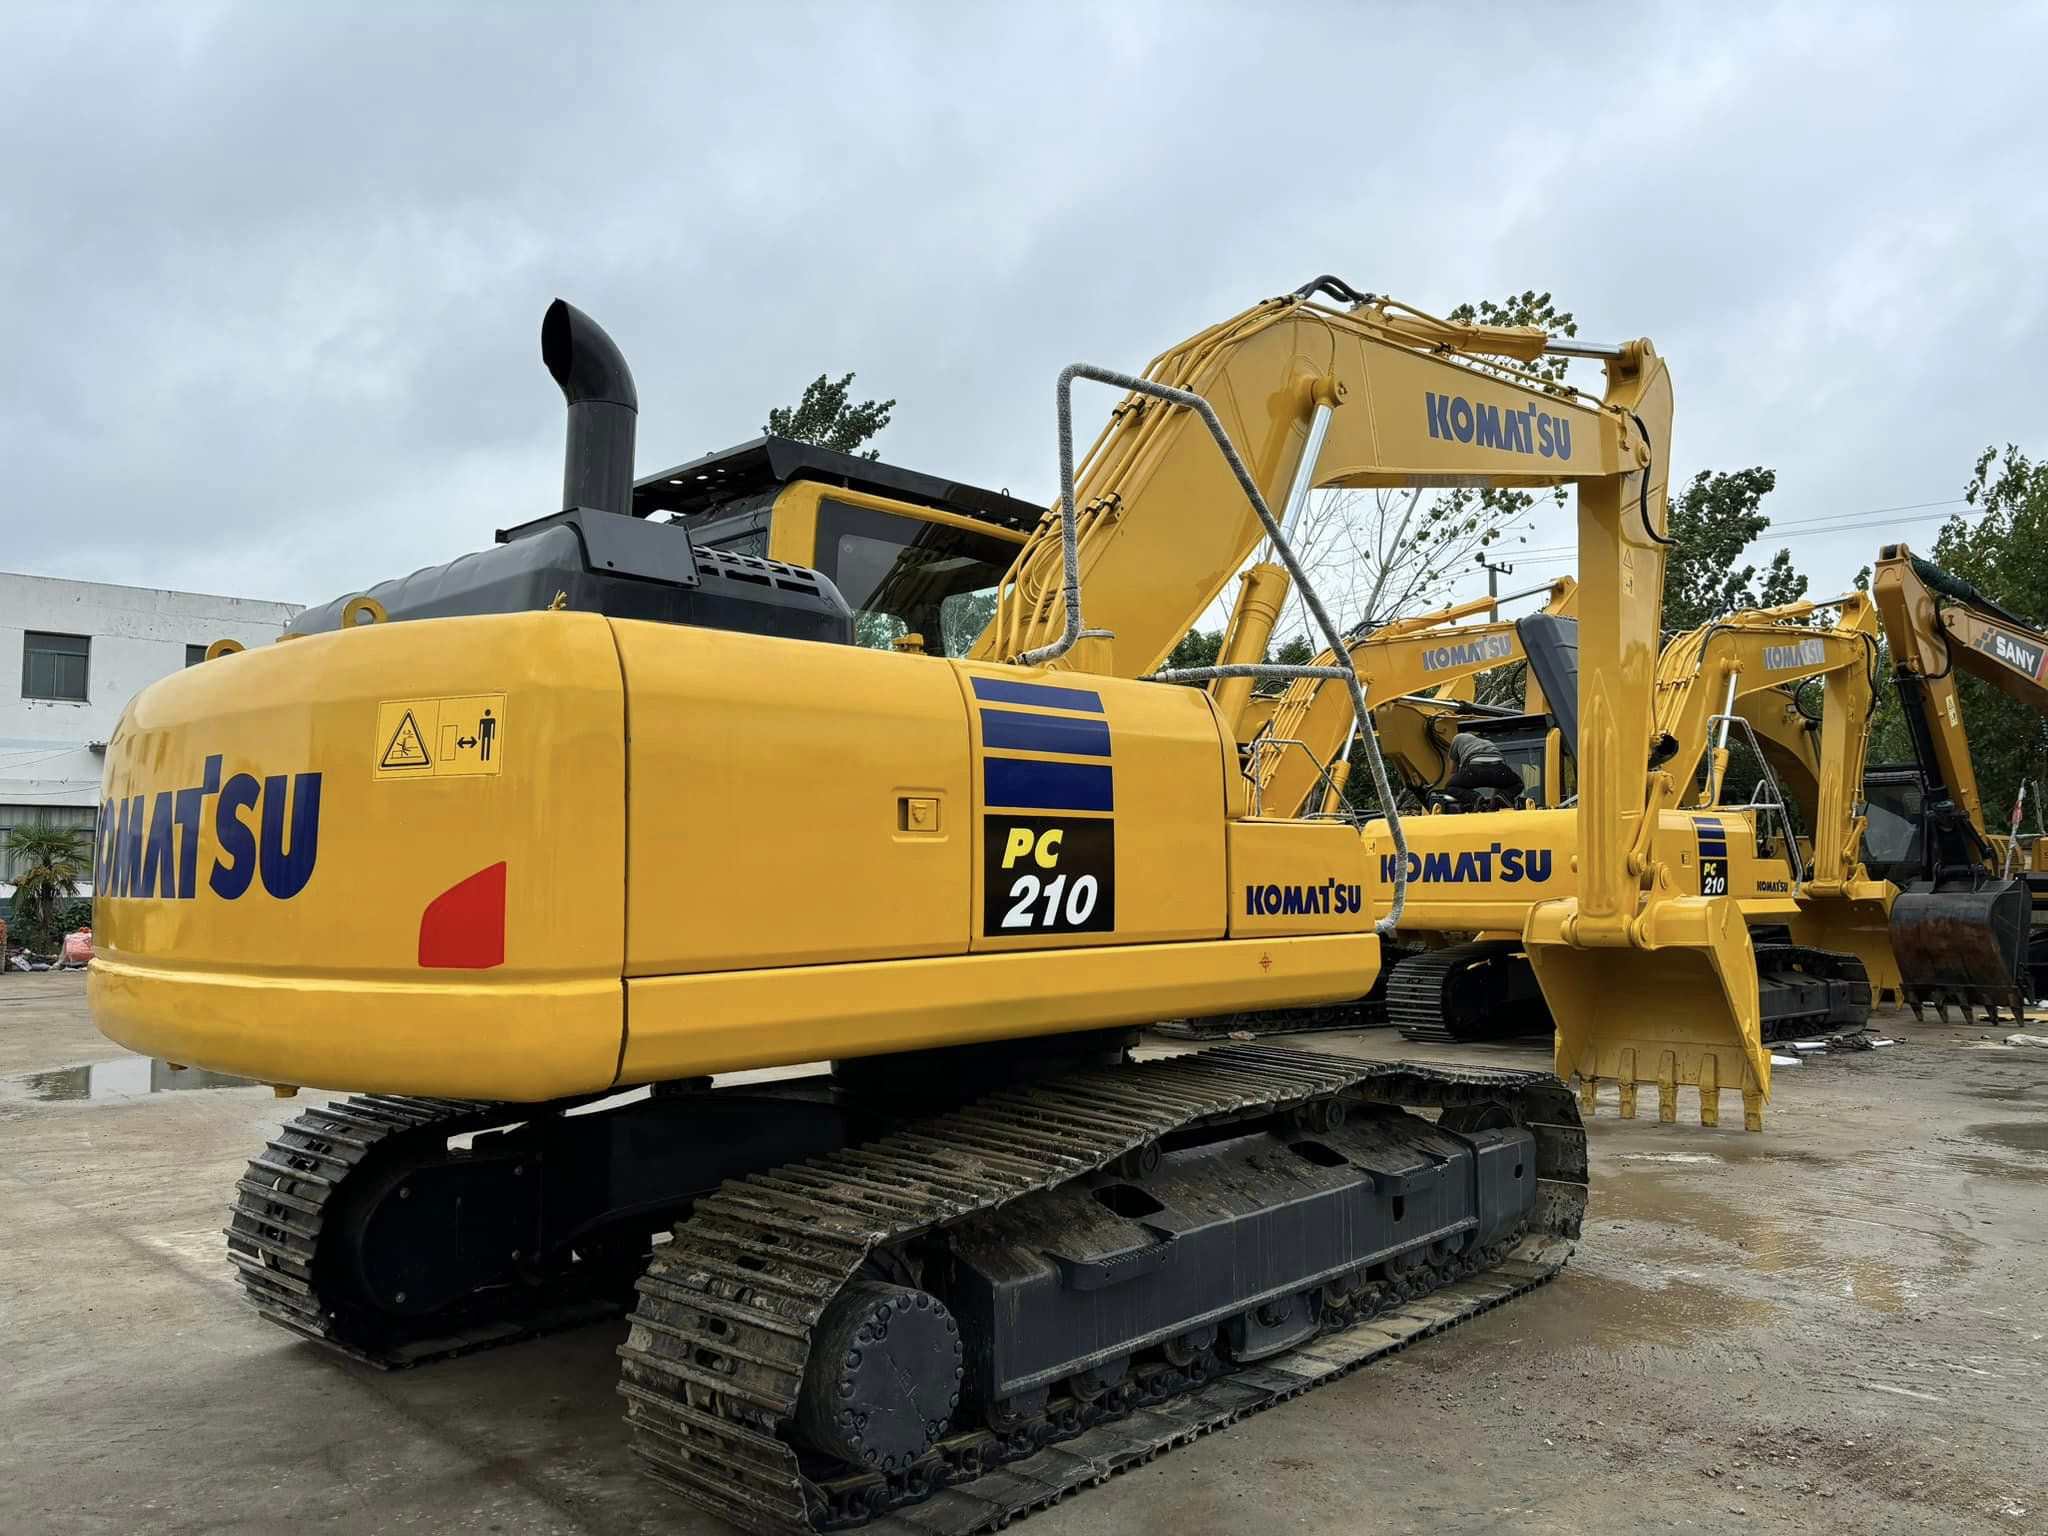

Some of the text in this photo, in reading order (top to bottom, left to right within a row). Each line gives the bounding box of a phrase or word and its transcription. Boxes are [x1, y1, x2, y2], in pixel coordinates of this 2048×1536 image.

[1425, 392, 1571, 460] KOMATSU
[1423, 635, 1511, 671] KOMATSU
[1996, 636, 2035, 672] SANY
[97, 754, 322, 900] OMATSU
[1001, 828, 1063, 868] PC
[1703, 863, 1717, 876] PC
[1704, 877, 1725, 894] 210
[1757, 880, 1788, 892] KOMATSU
[1001, 874, 1098, 928] 210
[1246, 877, 1361, 915] KOMATSU
